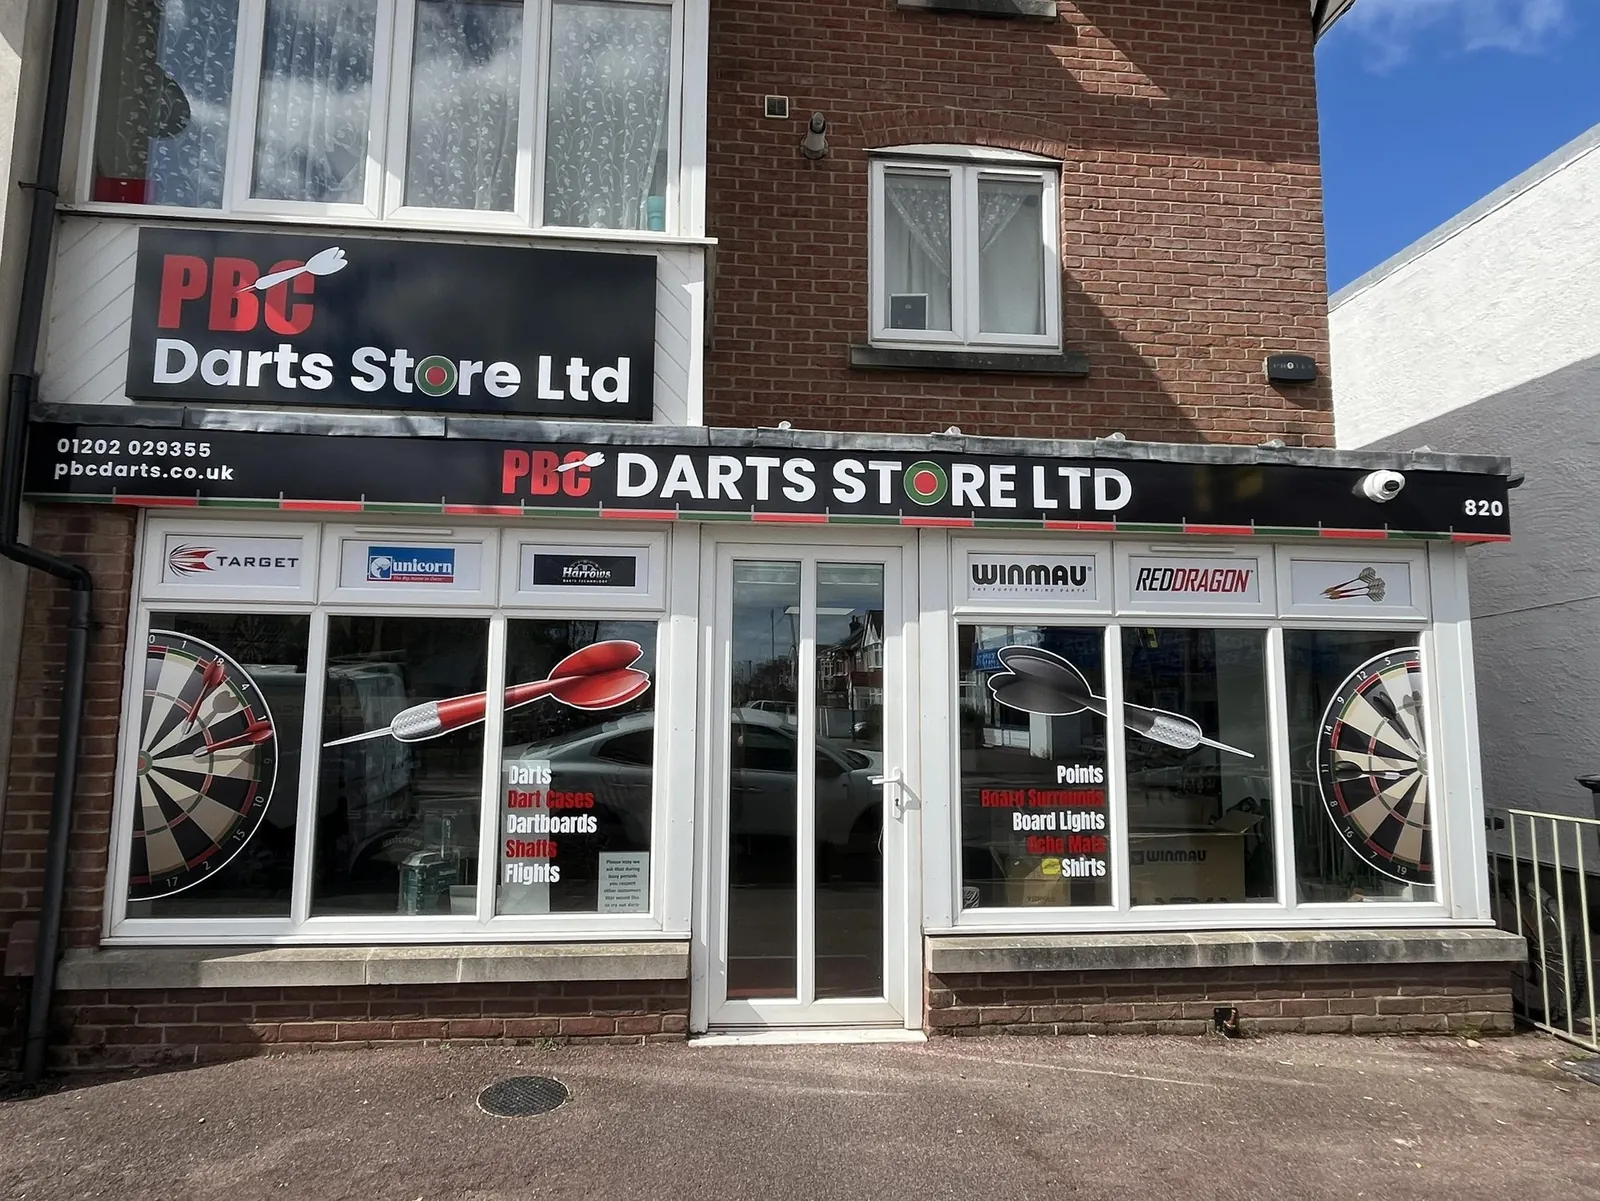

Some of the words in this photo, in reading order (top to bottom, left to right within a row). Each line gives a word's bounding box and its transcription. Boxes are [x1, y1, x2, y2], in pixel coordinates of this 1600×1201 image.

[157, 253, 315, 335] PBC
[152, 338, 333, 390] Darts
[350, 346, 521, 398] Store
[537, 355, 631, 403] Ltd
[57, 438, 121, 456] 01202
[127, 440, 211, 458] 029355
[54, 460, 234, 481] pbcdarts.co.uk
[502, 449, 593, 498] PBC
[616, 451, 816, 503] DARTS
[832, 458, 1015, 507] STORE
[1032, 464, 1133, 511] LTD
[1464, 498, 1503, 517] 820
[216, 556, 300, 568] TARGET
[393, 558, 453, 574] unicorn
[562, 566, 611, 578] Harrows
[1135, 567, 1251, 592] REDDRAGON
[1385, 656, 1391, 666] 5
[1356, 670, 1368, 682] 12
[1337, 696, 1345, 705] 9
[1324, 724, 1333, 737] 14
[508, 765, 552, 785] Darts
[1057, 764, 1104, 784] Points
[253, 795, 265, 809] 10
[508, 790, 541, 808] Dart
[546, 790, 595, 808] Cases
[981, 789, 1024, 808] Board
[1330, 800, 1338, 808] 8
[507, 814, 597, 834] Dartboards
[1013, 811, 1056, 831] Board
[1059, 811, 1105, 832] Lights
[232, 829, 246, 842] 15
[1343, 826, 1354, 838] 16
[506, 839, 558, 858] Shafts
[1068, 835, 1107, 854] Mats
[1370, 851, 1377, 859] 7
[203, 861, 211, 871] 2
[505, 863, 560, 886] Flights
[1062, 857, 1106, 878] Shirts
[1396, 864, 1407, 875] 19
[166, 877, 179, 888] 17
